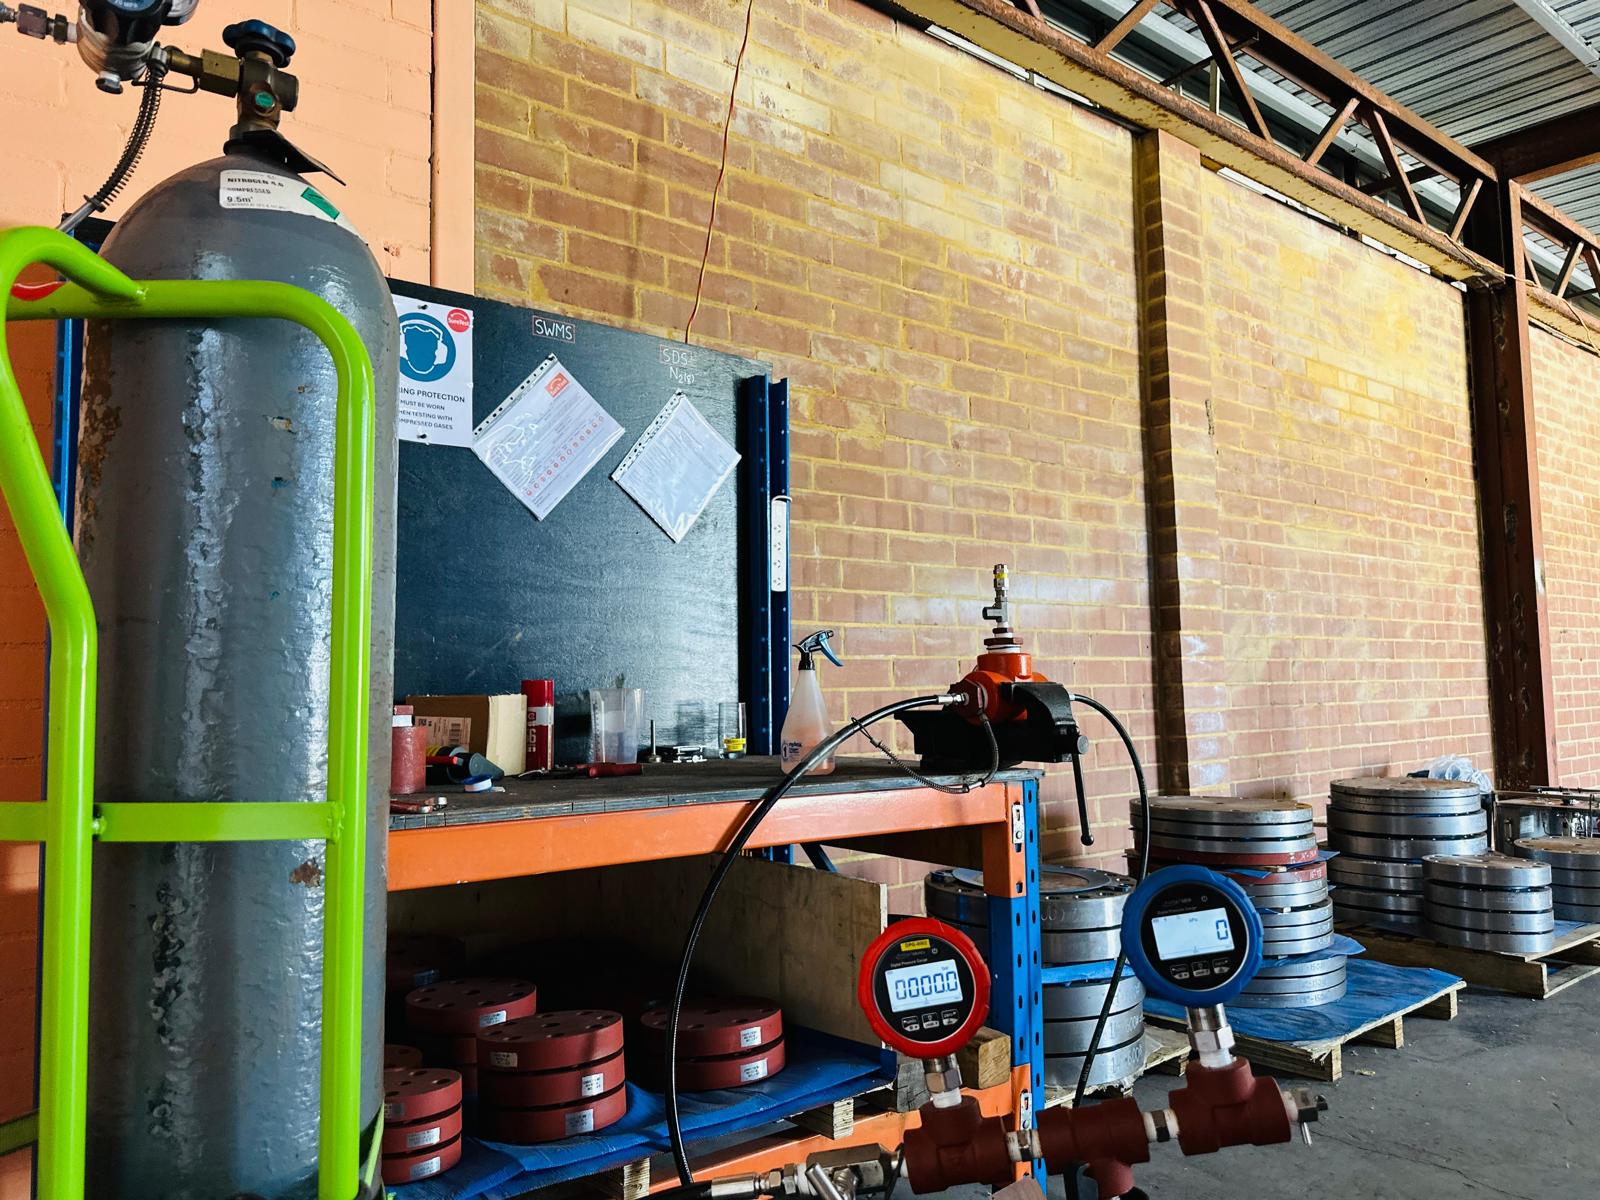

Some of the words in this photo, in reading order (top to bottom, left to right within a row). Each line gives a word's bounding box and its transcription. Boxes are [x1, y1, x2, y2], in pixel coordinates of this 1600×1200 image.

[227, 177, 269, 185] NITROGEN
[534, 318, 574, 341] SWMS
[399, 388, 416, 396] ING
[417, 390, 466, 403] PROTECTION
[400, 399, 417, 407] MUST
[426, 402, 445, 411] WORN
[412, 411, 436, 420] TESTING
[436, 413, 453, 421] WITH
[433, 422, 453, 430] GASES
[1216, 919, 1228, 940] 0
